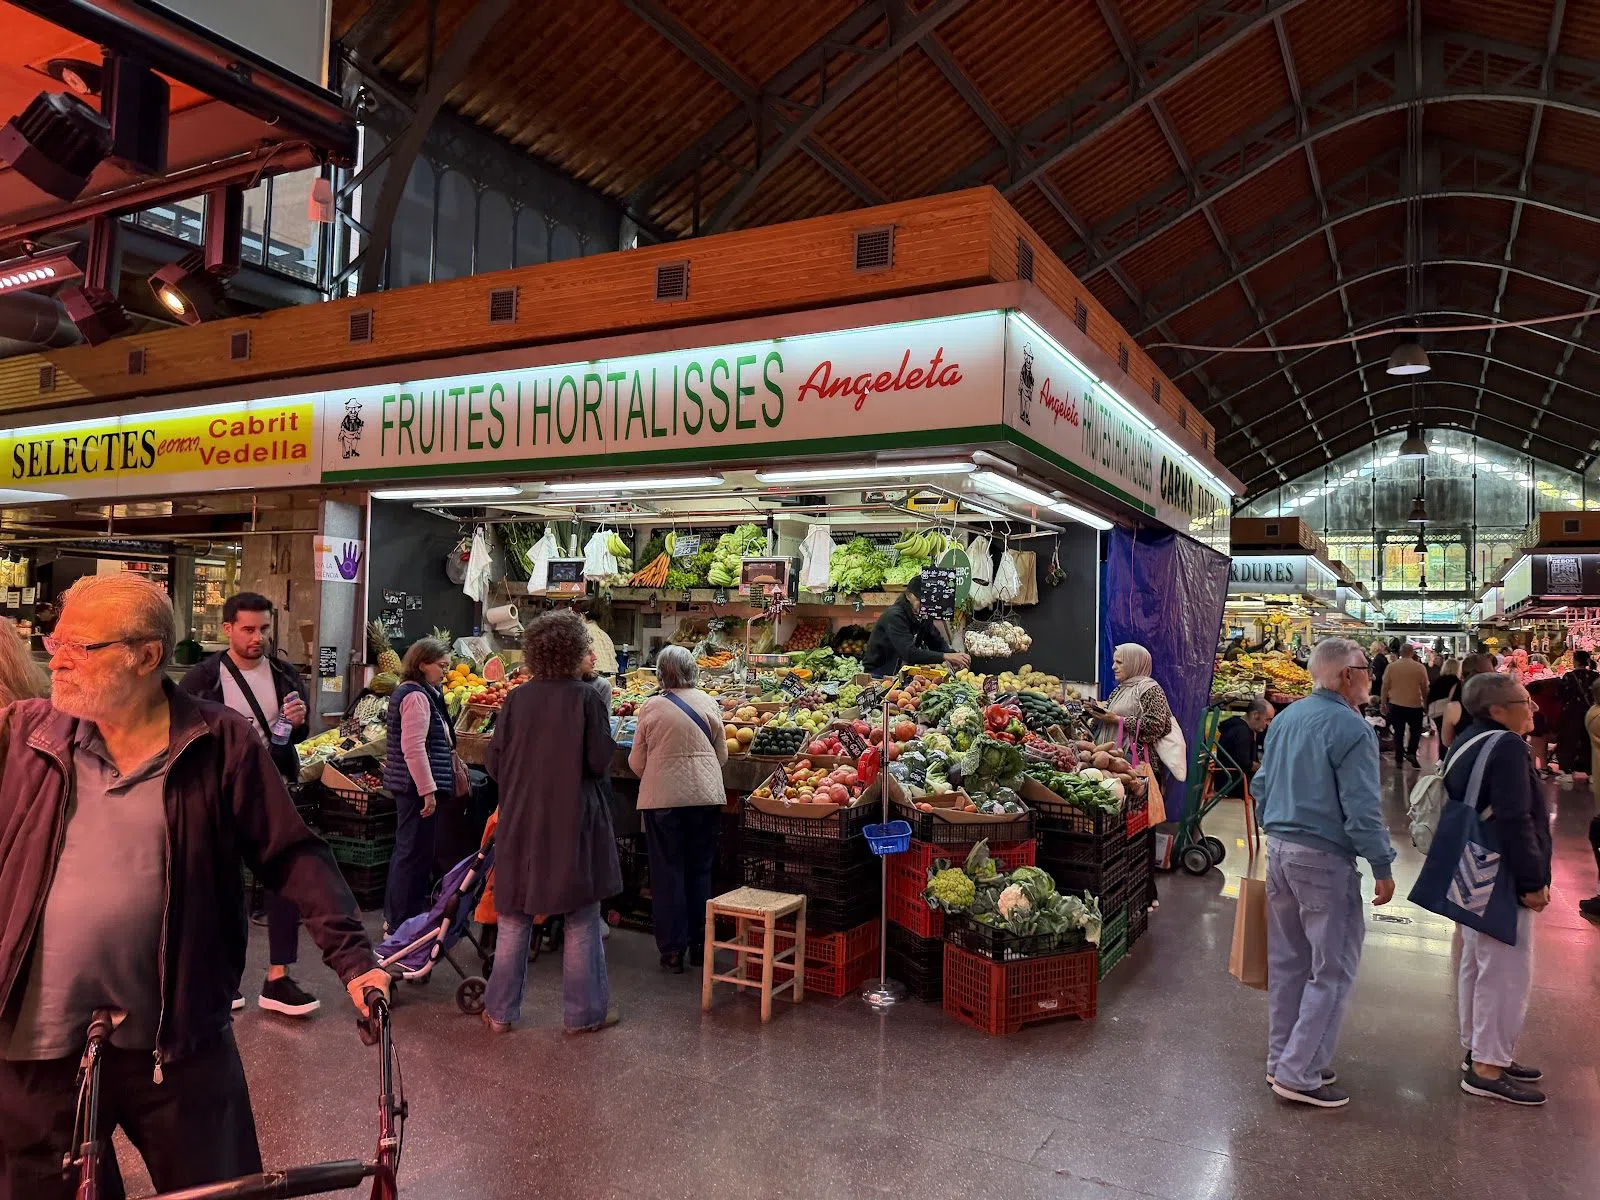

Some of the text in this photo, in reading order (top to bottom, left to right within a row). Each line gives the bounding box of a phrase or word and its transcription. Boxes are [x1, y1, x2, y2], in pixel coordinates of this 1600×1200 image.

[208, 412, 299, 438] Cabrit
[381, 346, 963, 456] FRUITES I HORTALISSES Angeleta
[1039, 377, 1079, 427] Angeleta
[12, 429, 156, 479] SELECTES
[199, 440, 307, 465] Vedella
[1160, 455, 1194, 516] CARNS
